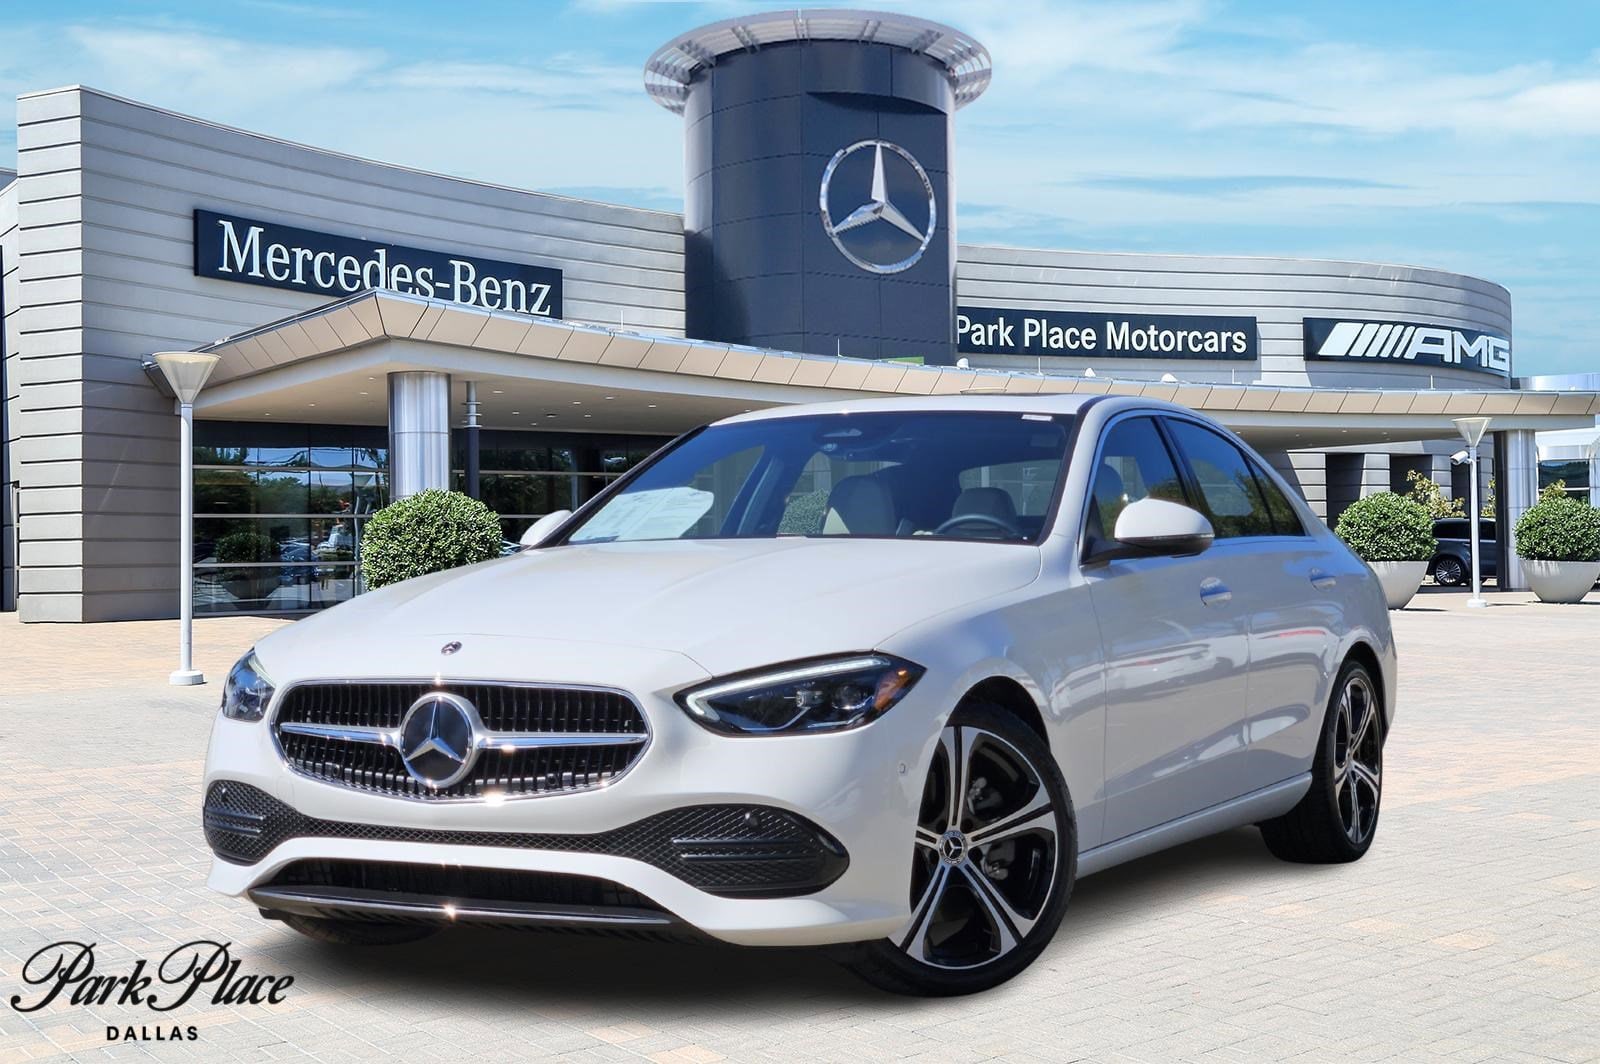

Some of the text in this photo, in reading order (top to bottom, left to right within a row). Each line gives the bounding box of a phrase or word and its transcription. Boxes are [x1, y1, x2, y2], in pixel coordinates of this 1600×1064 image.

[218, 220, 552, 316] Mercedes-Benz
[957, 314, 1247, 353] Park Place Motorcars
[1403, 326, 1510, 371] AMG
